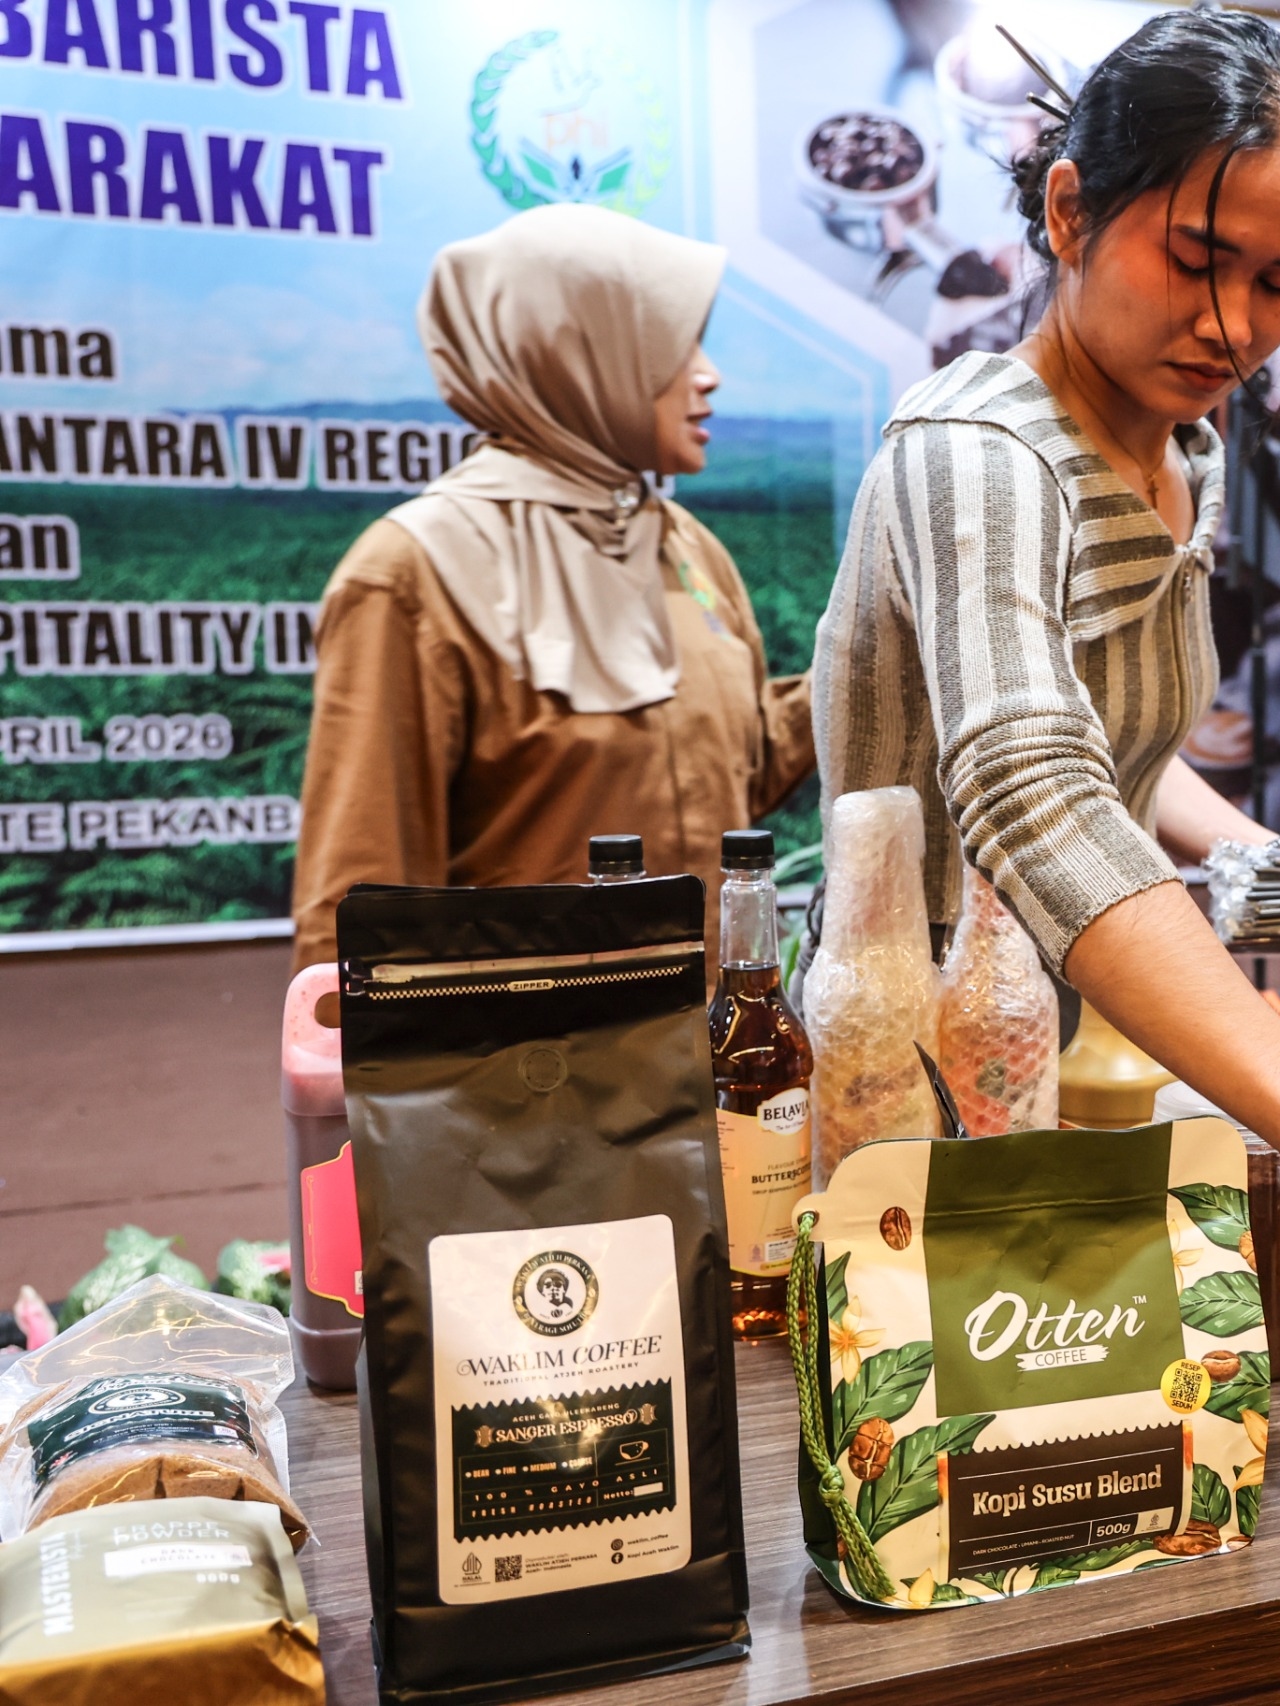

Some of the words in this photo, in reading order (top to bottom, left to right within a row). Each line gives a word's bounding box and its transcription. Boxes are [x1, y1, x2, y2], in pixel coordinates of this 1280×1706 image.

[246, 424, 303, 481] IV
[0, 720, 95, 754] RIL
[113, 719, 224, 752] 2026
[512, 979, 551, 991] ZIPPER
[963, 1290, 1147, 1362] Otten
[1132, 1295, 1147, 1305] TM
[456, 1348, 565, 1377] WAKLIM
[572, 1335, 663, 1364] COFFEE
[1034, 1348, 1088, 1367] COFFEE
[588, 1361, 640, 1374] ROASTERY
[1180, 1361, 1201, 1371] RESEP
[1171, 1399, 1193, 1411] SEDUH
[495, 1423, 558, 1445] SANGER
[559, 1409, 638, 1435] ESPRESSO
[512, 1414, 536, 1423] ACEH
[603, 1489, 634, 1500] Netto:
[972, 1484, 1026, 1517] Kopi
[1031, 1481, 1092, 1508] Susu
[1097, 1464, 1162, 1498] Blend
[112, 1520, 219, 1537] FRAPPE
[114, 1528, 230, 1546] POWDER
[1096, 1522, 1131, 1538] 500g
